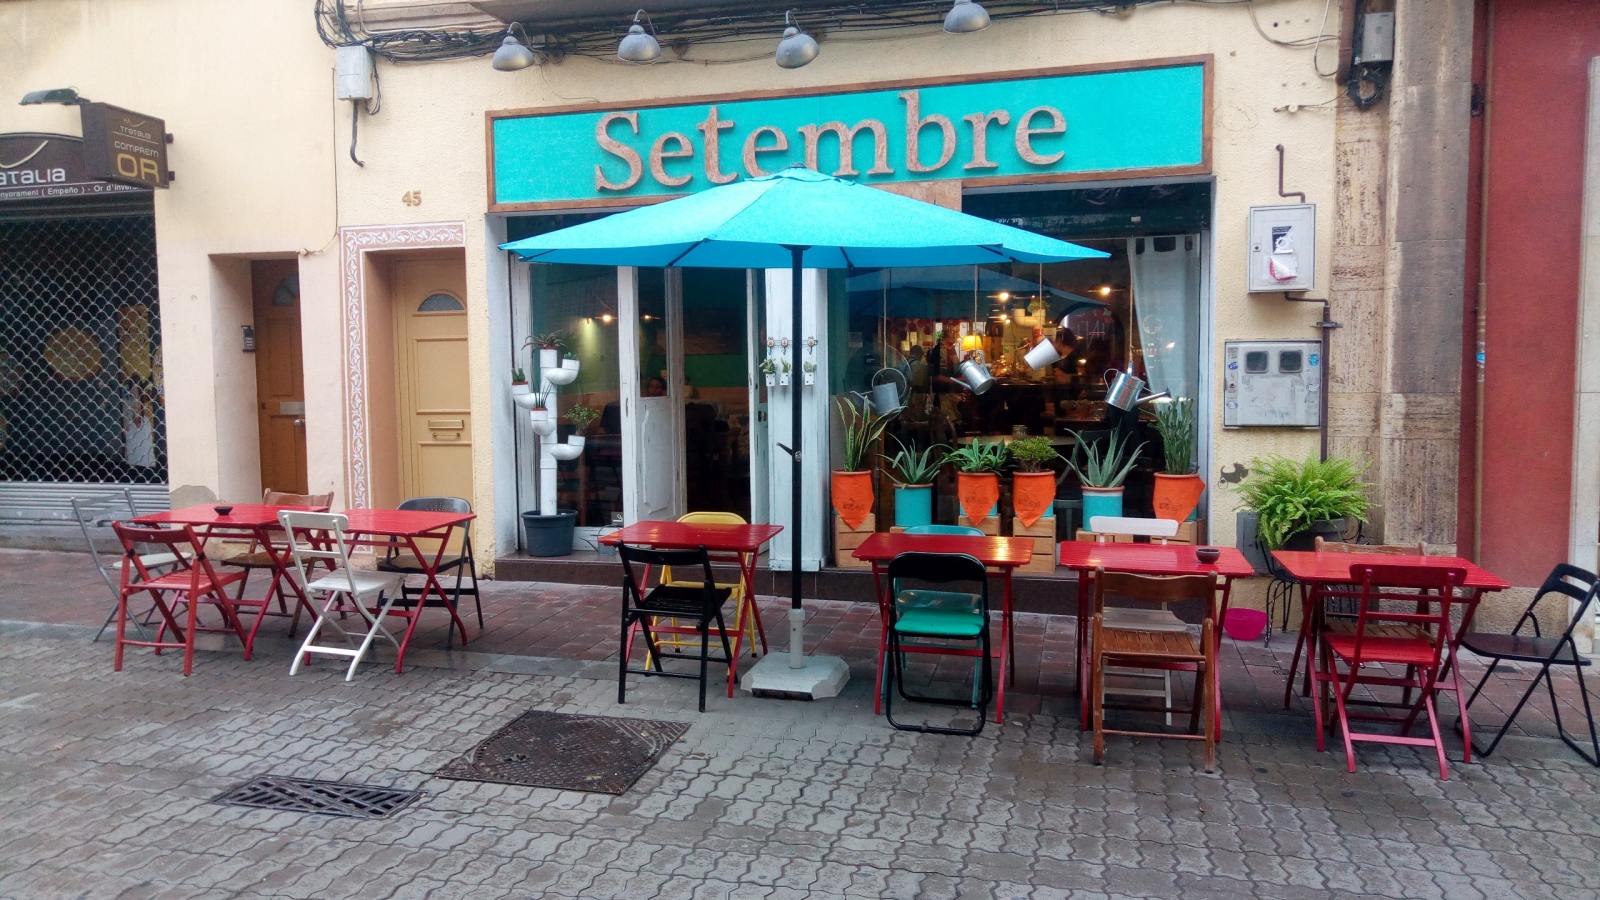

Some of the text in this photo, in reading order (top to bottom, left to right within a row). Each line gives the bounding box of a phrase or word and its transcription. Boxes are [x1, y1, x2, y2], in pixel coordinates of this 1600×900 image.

[594, 88, 1068, 193] Setembre
[117, 153, 160, 183] OR
[93, 184, 103, 192] Or
[401, 190, 422, 207] 45
